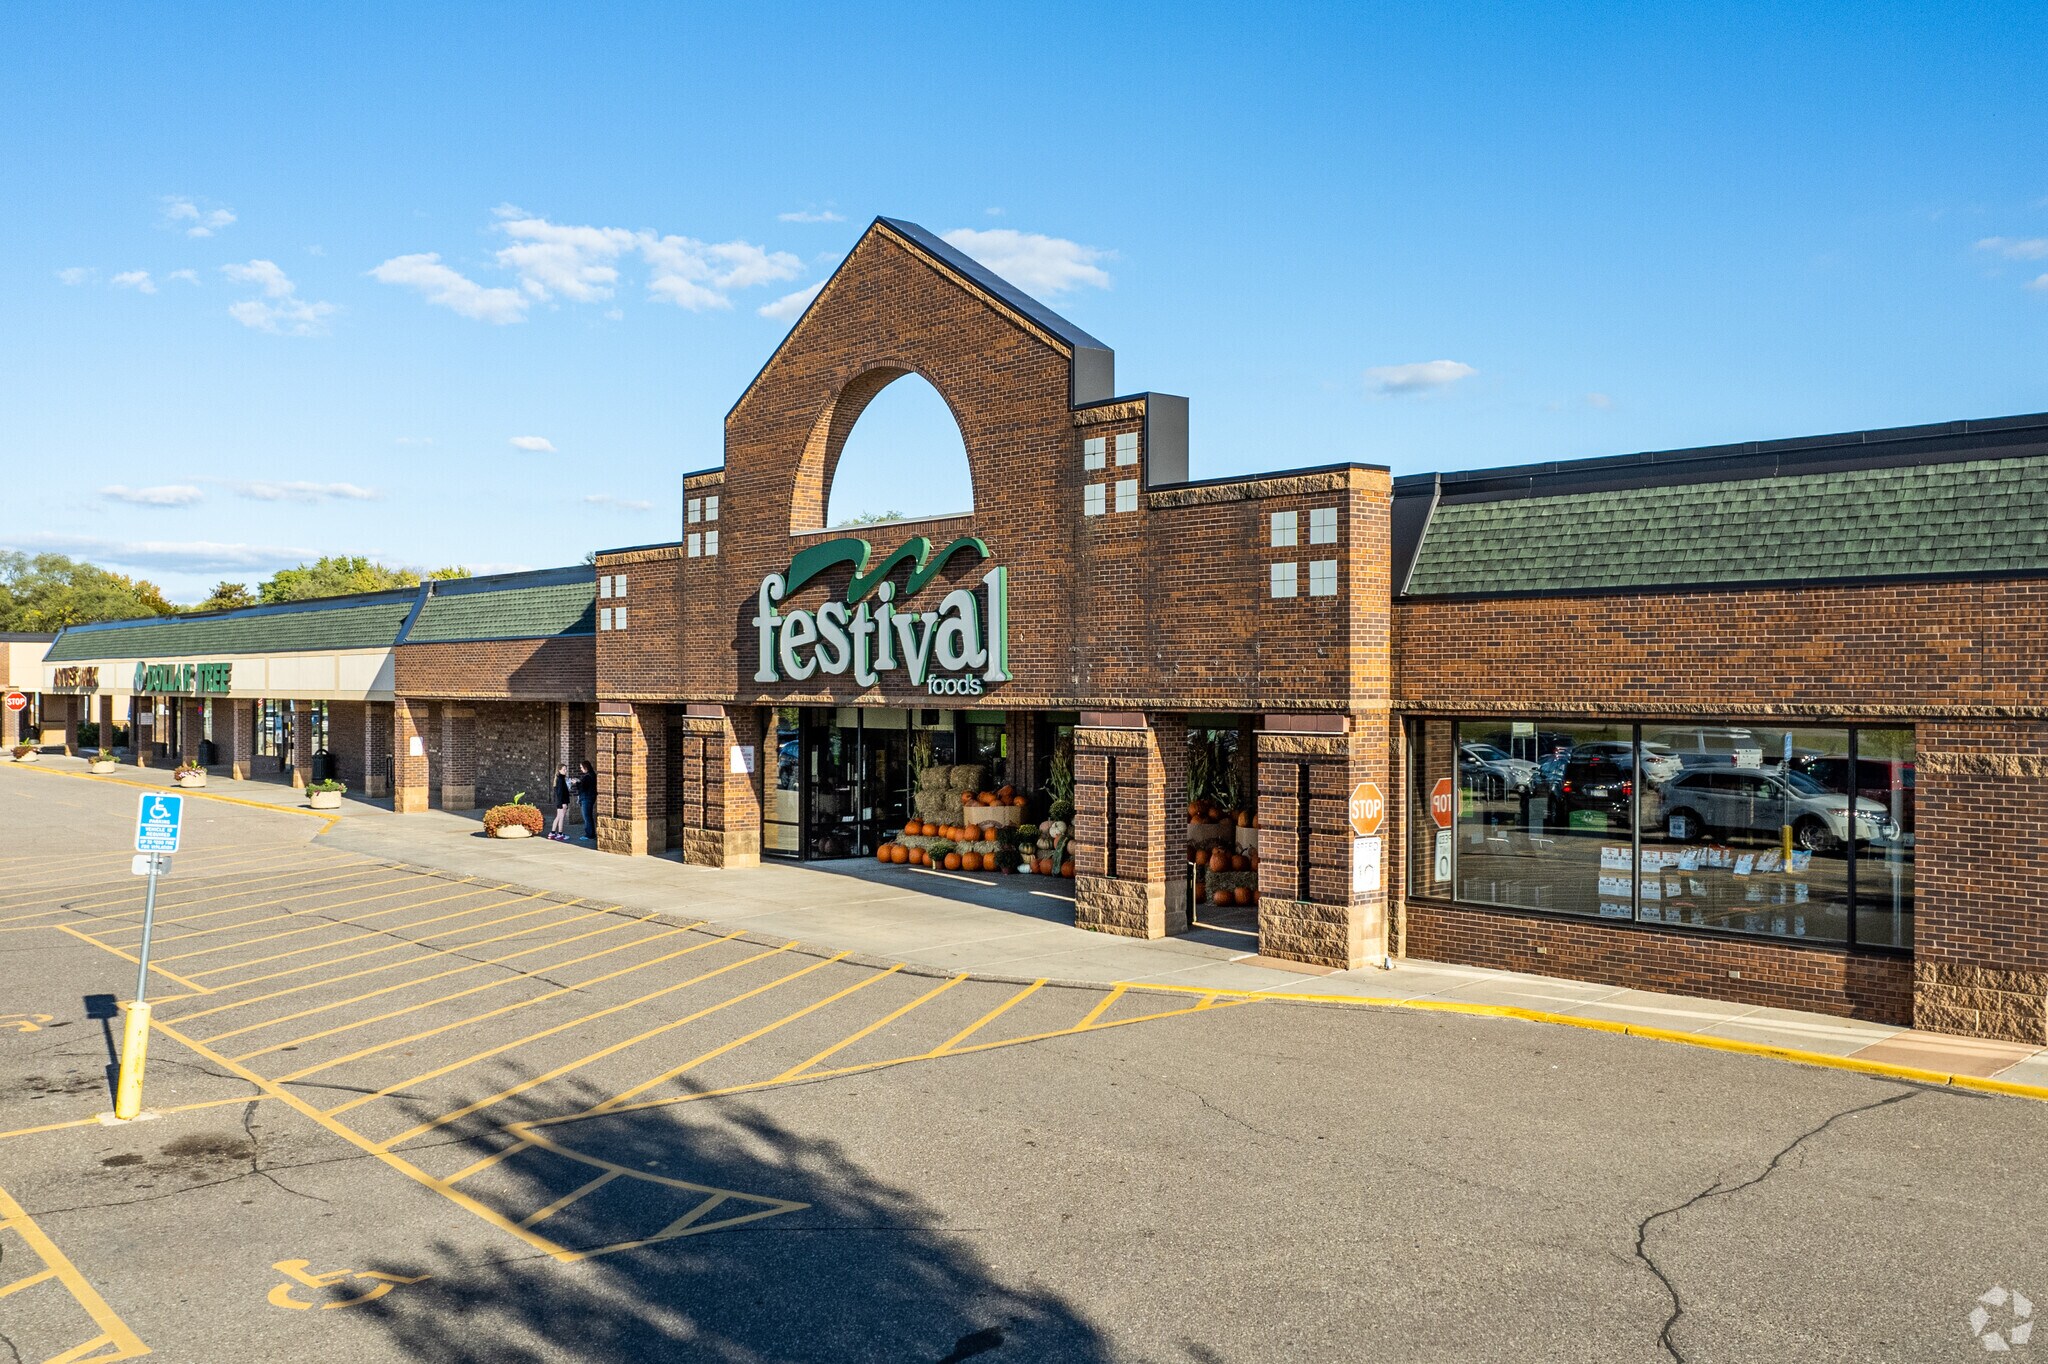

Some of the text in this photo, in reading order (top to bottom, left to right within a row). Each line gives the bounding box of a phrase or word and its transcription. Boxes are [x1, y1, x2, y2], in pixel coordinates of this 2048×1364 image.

[752, 565, 1013, 688] festival
[145, 662, 232, 693] DOLLAR TREE
[926, 673, 985, 696] foods
[7, 697, 25, 706] STOP
[1351, 799, 1381, 819] STOP
